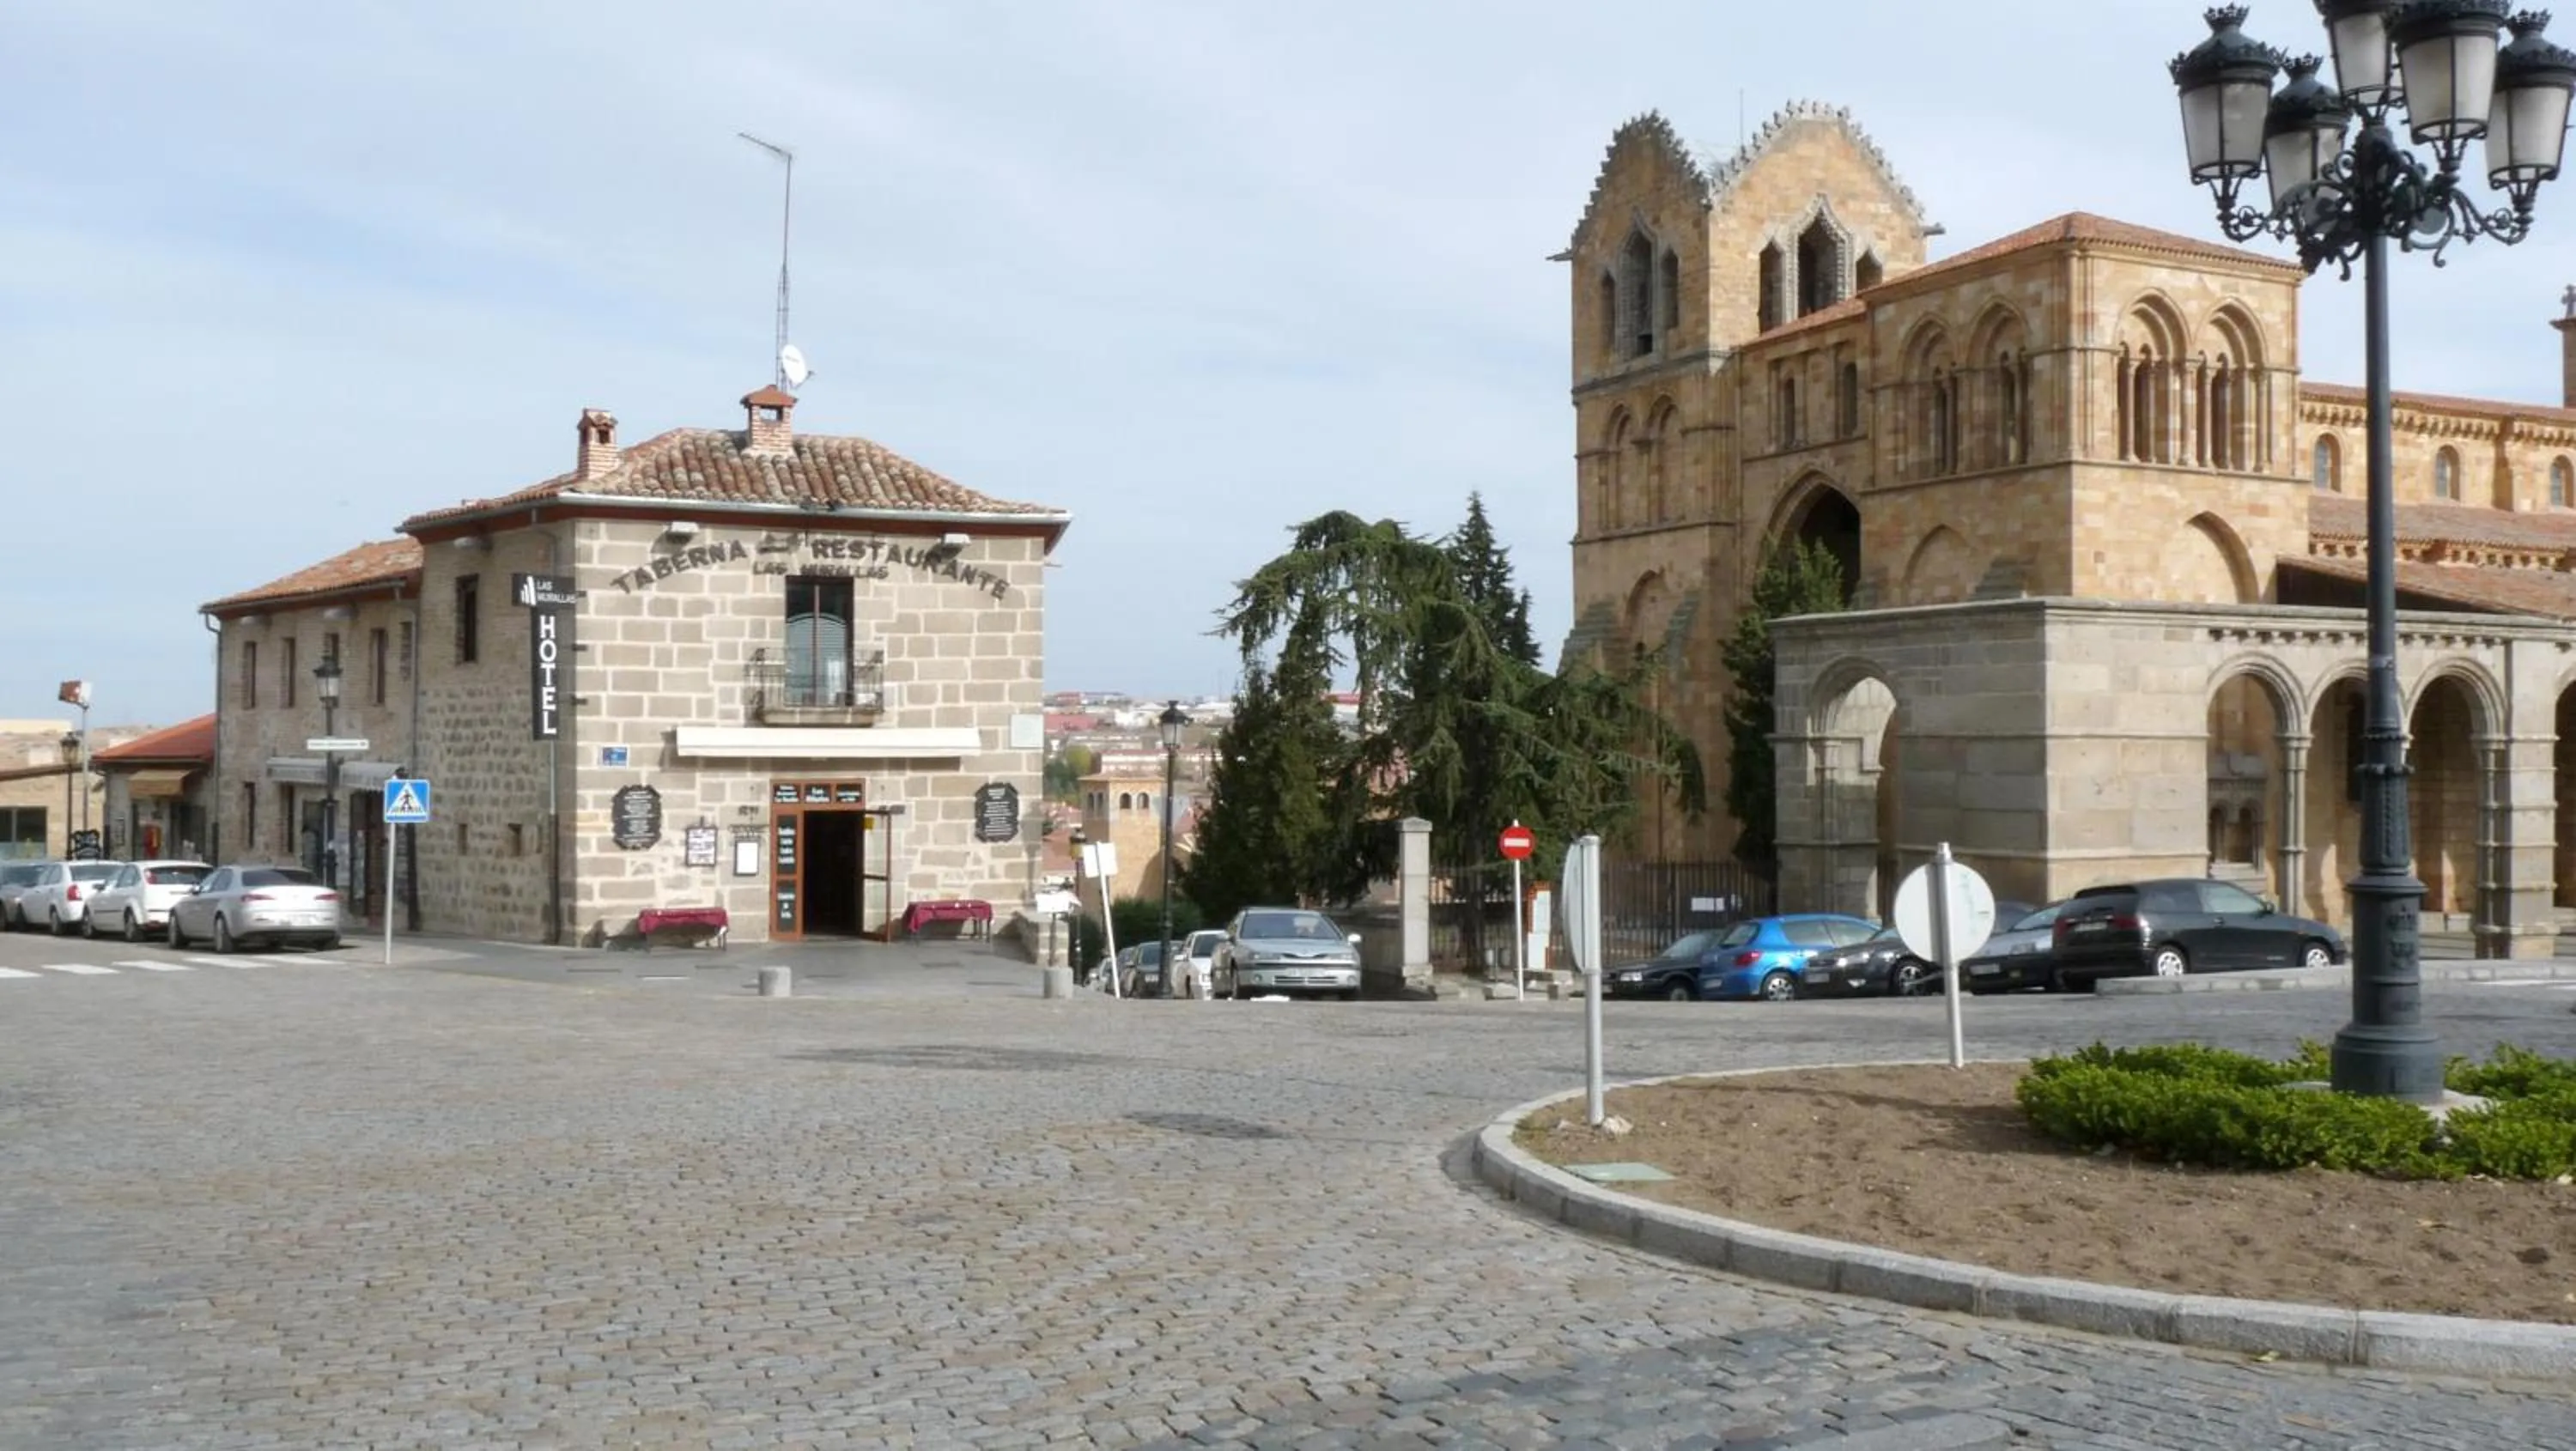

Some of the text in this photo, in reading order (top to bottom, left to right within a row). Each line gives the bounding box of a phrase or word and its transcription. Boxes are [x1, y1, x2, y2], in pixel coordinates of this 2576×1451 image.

[610, 537, 1010, 601] TABERNA RESTAURANTE
[752, 561, 788, 575] LAS
[537, 581, 553, 591] LAS
[537, 592, 577, 604] MURALLAS
[539, 615, 557, 735] HOTEL
